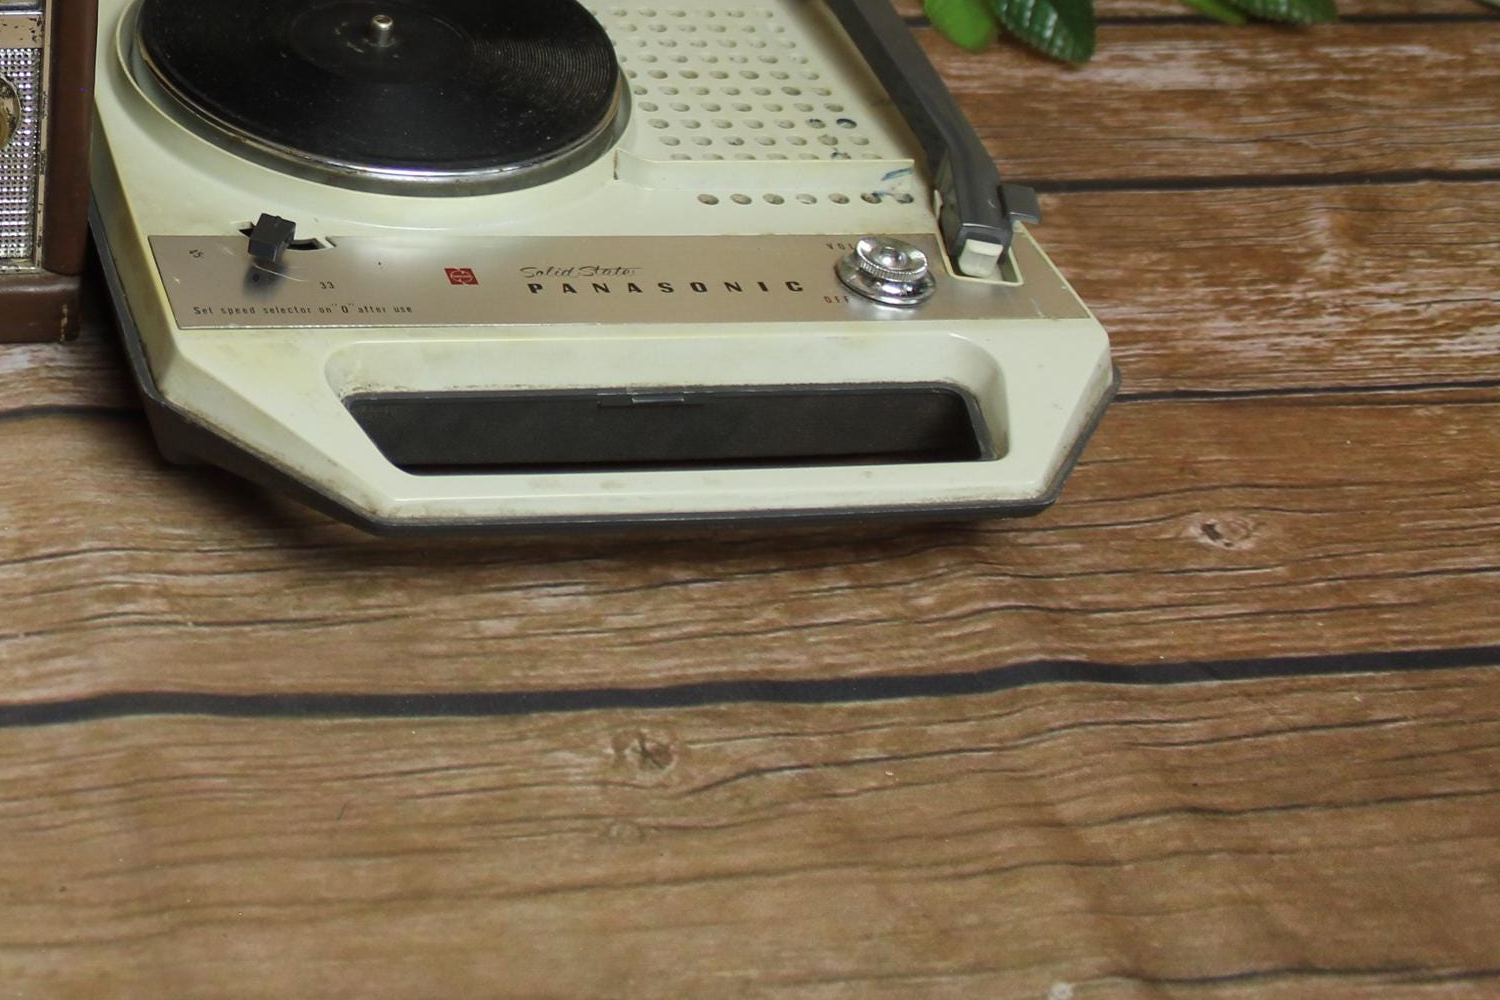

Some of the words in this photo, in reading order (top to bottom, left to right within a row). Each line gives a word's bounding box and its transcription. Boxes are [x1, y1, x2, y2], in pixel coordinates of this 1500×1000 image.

[520, 266, 574, 278] Solid
[319, 281, 335, 290] 33
[527, 281, 804, 294] PANASONIC
[193, 305, 213, 315] Set
[220, 305, 256, 316] speed
[263, 305, 311, 315] selector
[319, 306, 332, 314] on
[358, 305, 387, 314] after
[394, 305, 413, 314] use
